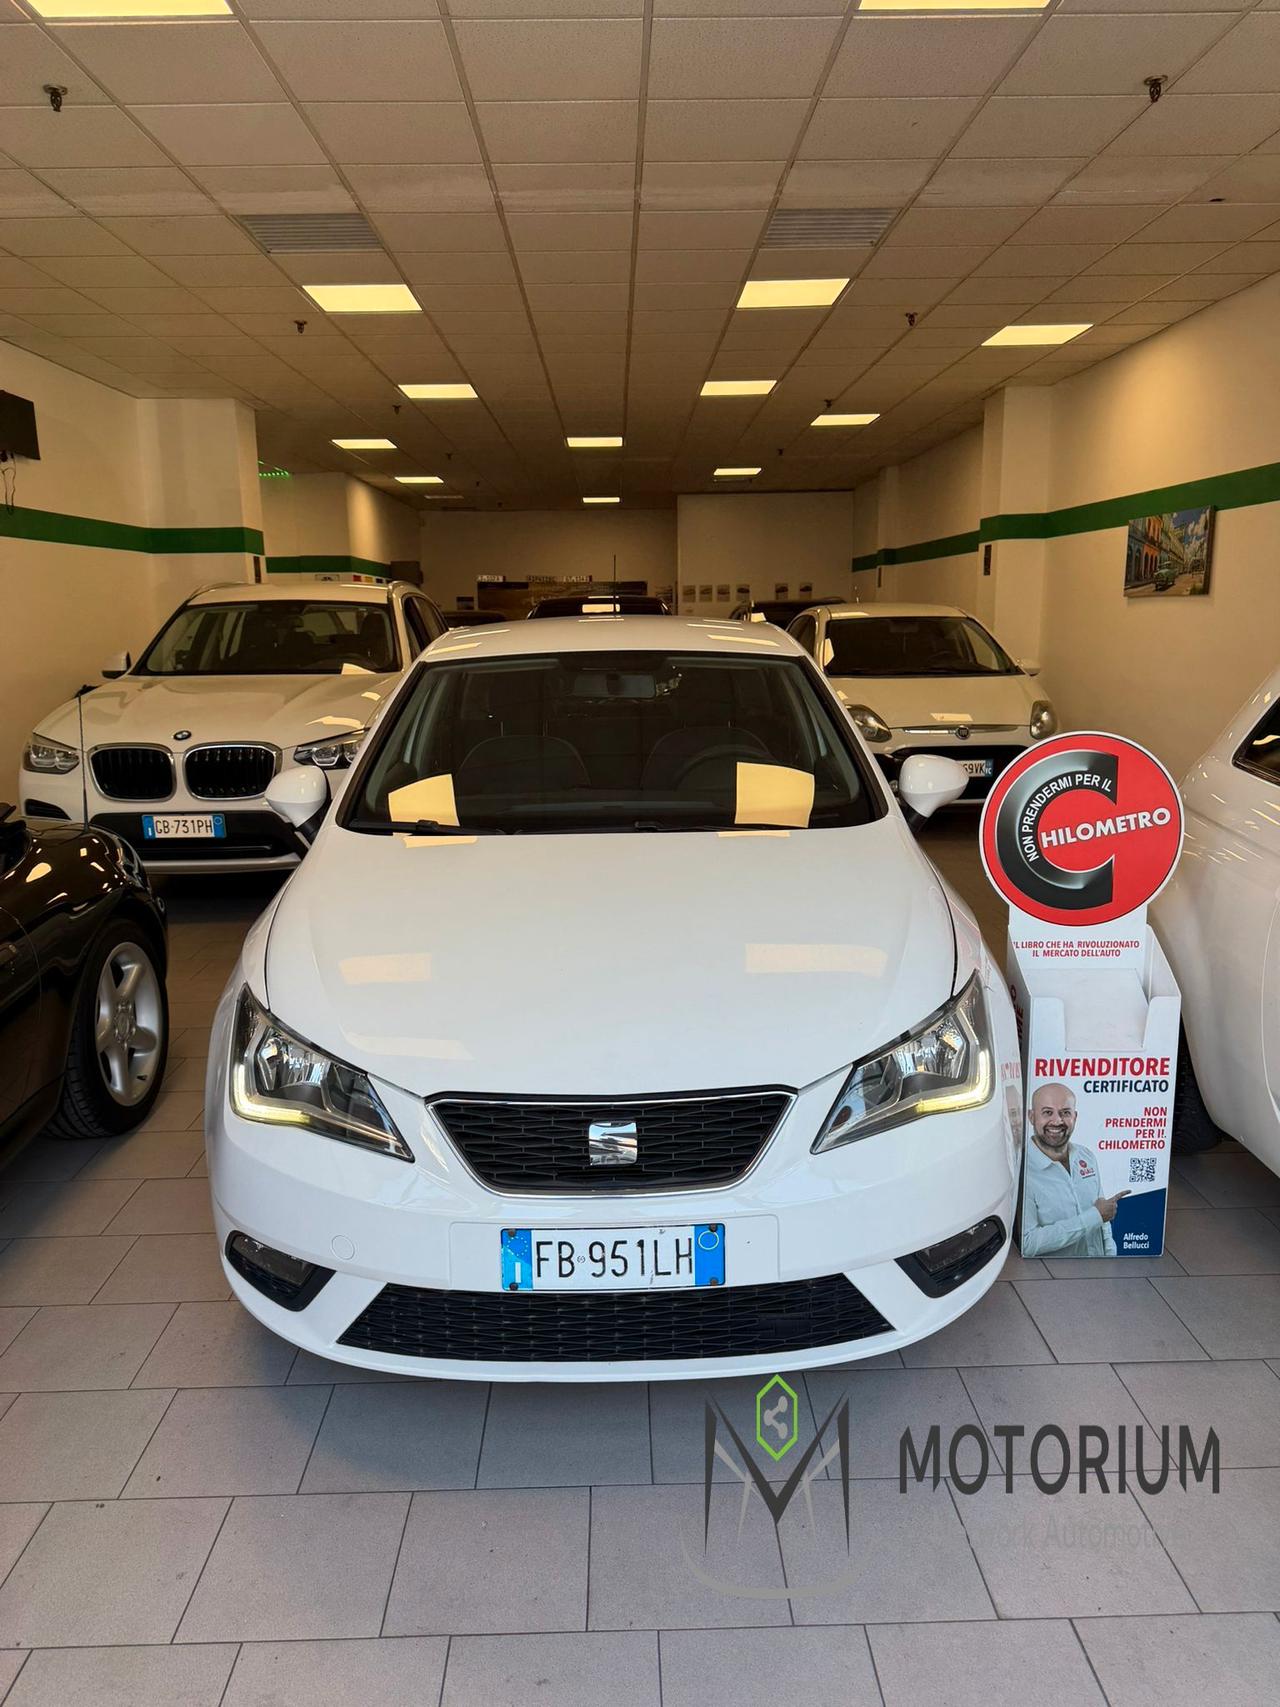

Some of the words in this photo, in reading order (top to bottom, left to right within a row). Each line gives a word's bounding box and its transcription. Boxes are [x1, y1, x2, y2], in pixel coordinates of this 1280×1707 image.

[1075, 774, 1100, 787] PER
[1101, 777, 1112, 793] IL
[1022, 775, 1073, 833] PRENDERMI
[1022, 834, 1039, 862] NON
[1021, 941, 1044, 949] LIBRO
[1045, 941, 1061, 949] CHE
[1063, 941, 1074, 949] HA
[1077, 940, 1140, 949] RIVOLUZIONATO
[1032, 949, 1040, 958] IL
[1042, 949, 1079, 957] MERCATO
[1081, 949, 1121, 957] DELL'AUTO
[1034, 1057, 1171, 1077] RIVENDITORE
[1083, 1079, 1169, 1093] CERTIFICATO
[1144, 1106, 1167, 1117] NON
[1105, 1117, 1167, 1128] PRENDERMI
[1135, 1128, 1155, 1138] PER
[1098, 1139, 1166, 1150] CHILOMETRO
[1123, 1232, 1149, 1241] Alfredo
[1123, 1240, 1150, 1249] Bellucci
